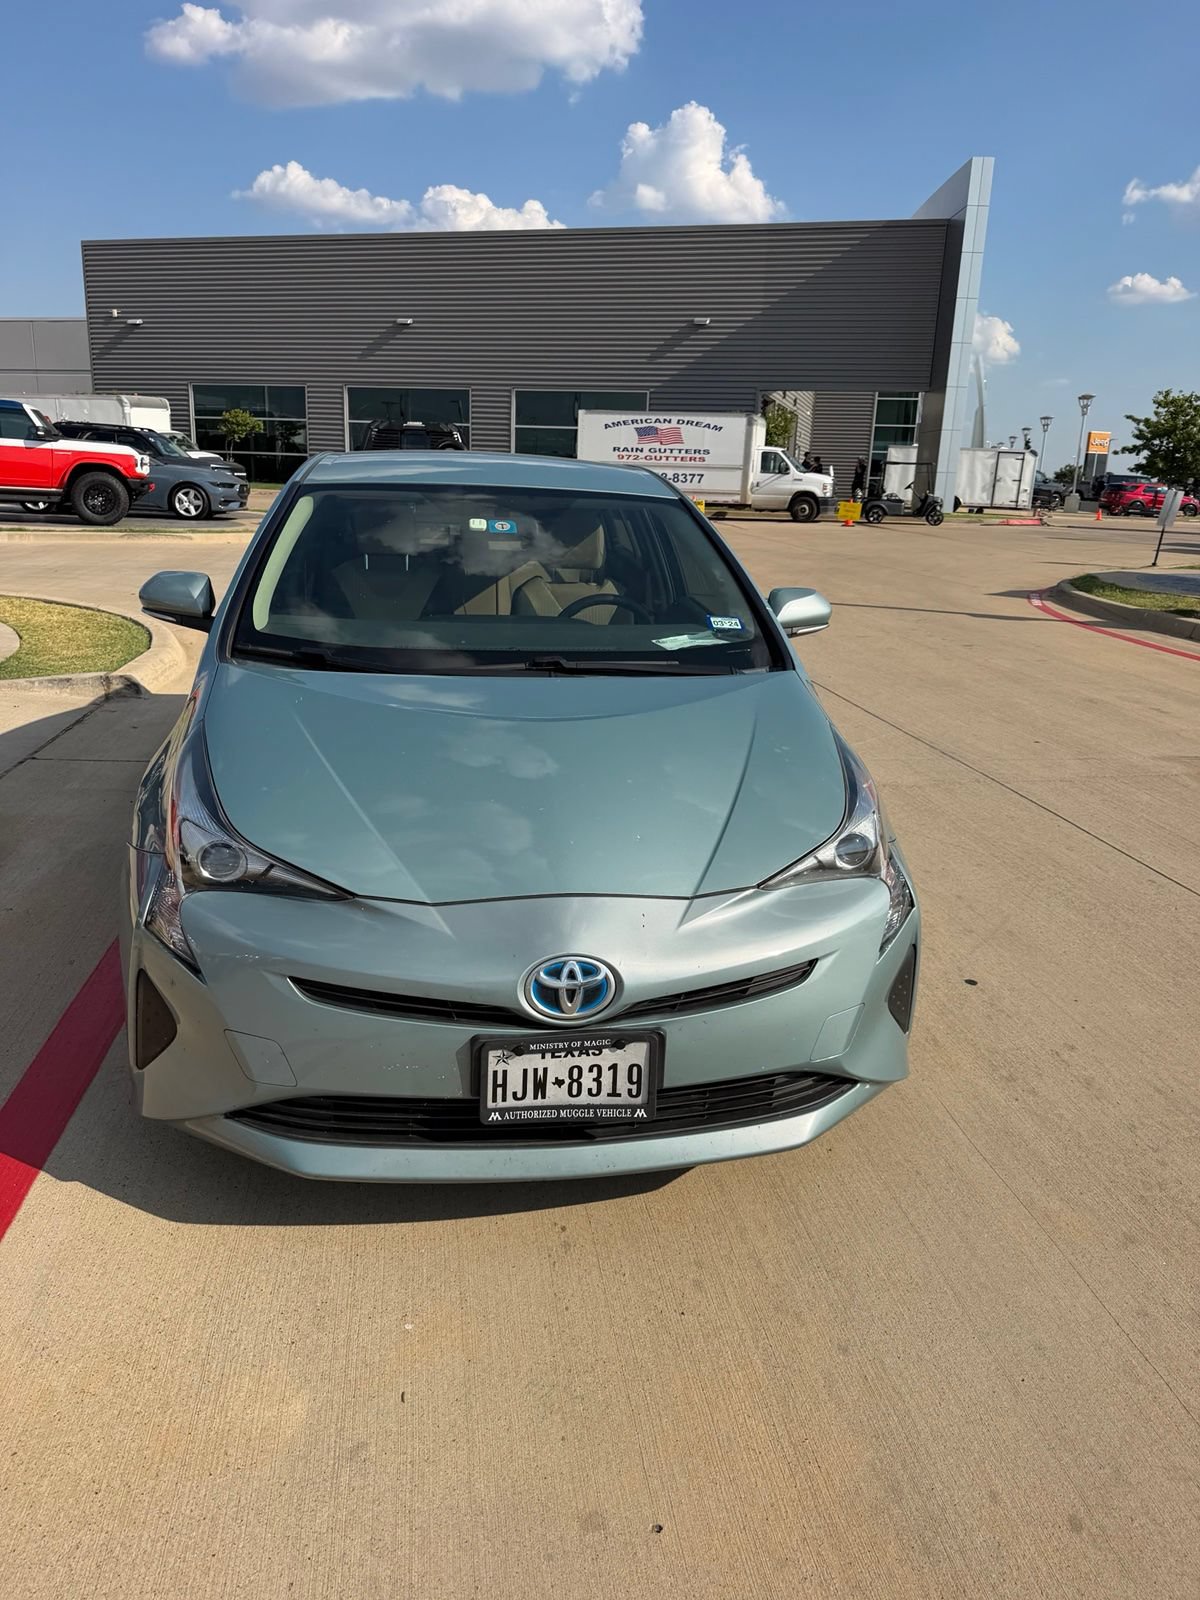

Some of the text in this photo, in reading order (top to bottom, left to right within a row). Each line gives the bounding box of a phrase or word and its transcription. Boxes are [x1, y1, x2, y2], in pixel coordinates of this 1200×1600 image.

[604, 418, 724, 432] AMERICAN DREAM
[1090, 438, 1109, 447] Jeep
[648, 447, 711, 455] GUTTERS
[617, 454, 706, 462] 972-GUTTERS
[529, 1039, 611, 1051] MINISTRY OF MAGIC
[491, 1063, 643, 1103] HJW 8319
[503, 1109, 557, 1120] AUTHORIZED
[559, 1108, 594, 1118] MUGGLE
[596, 1108, 632, 1117] VEHICLE
